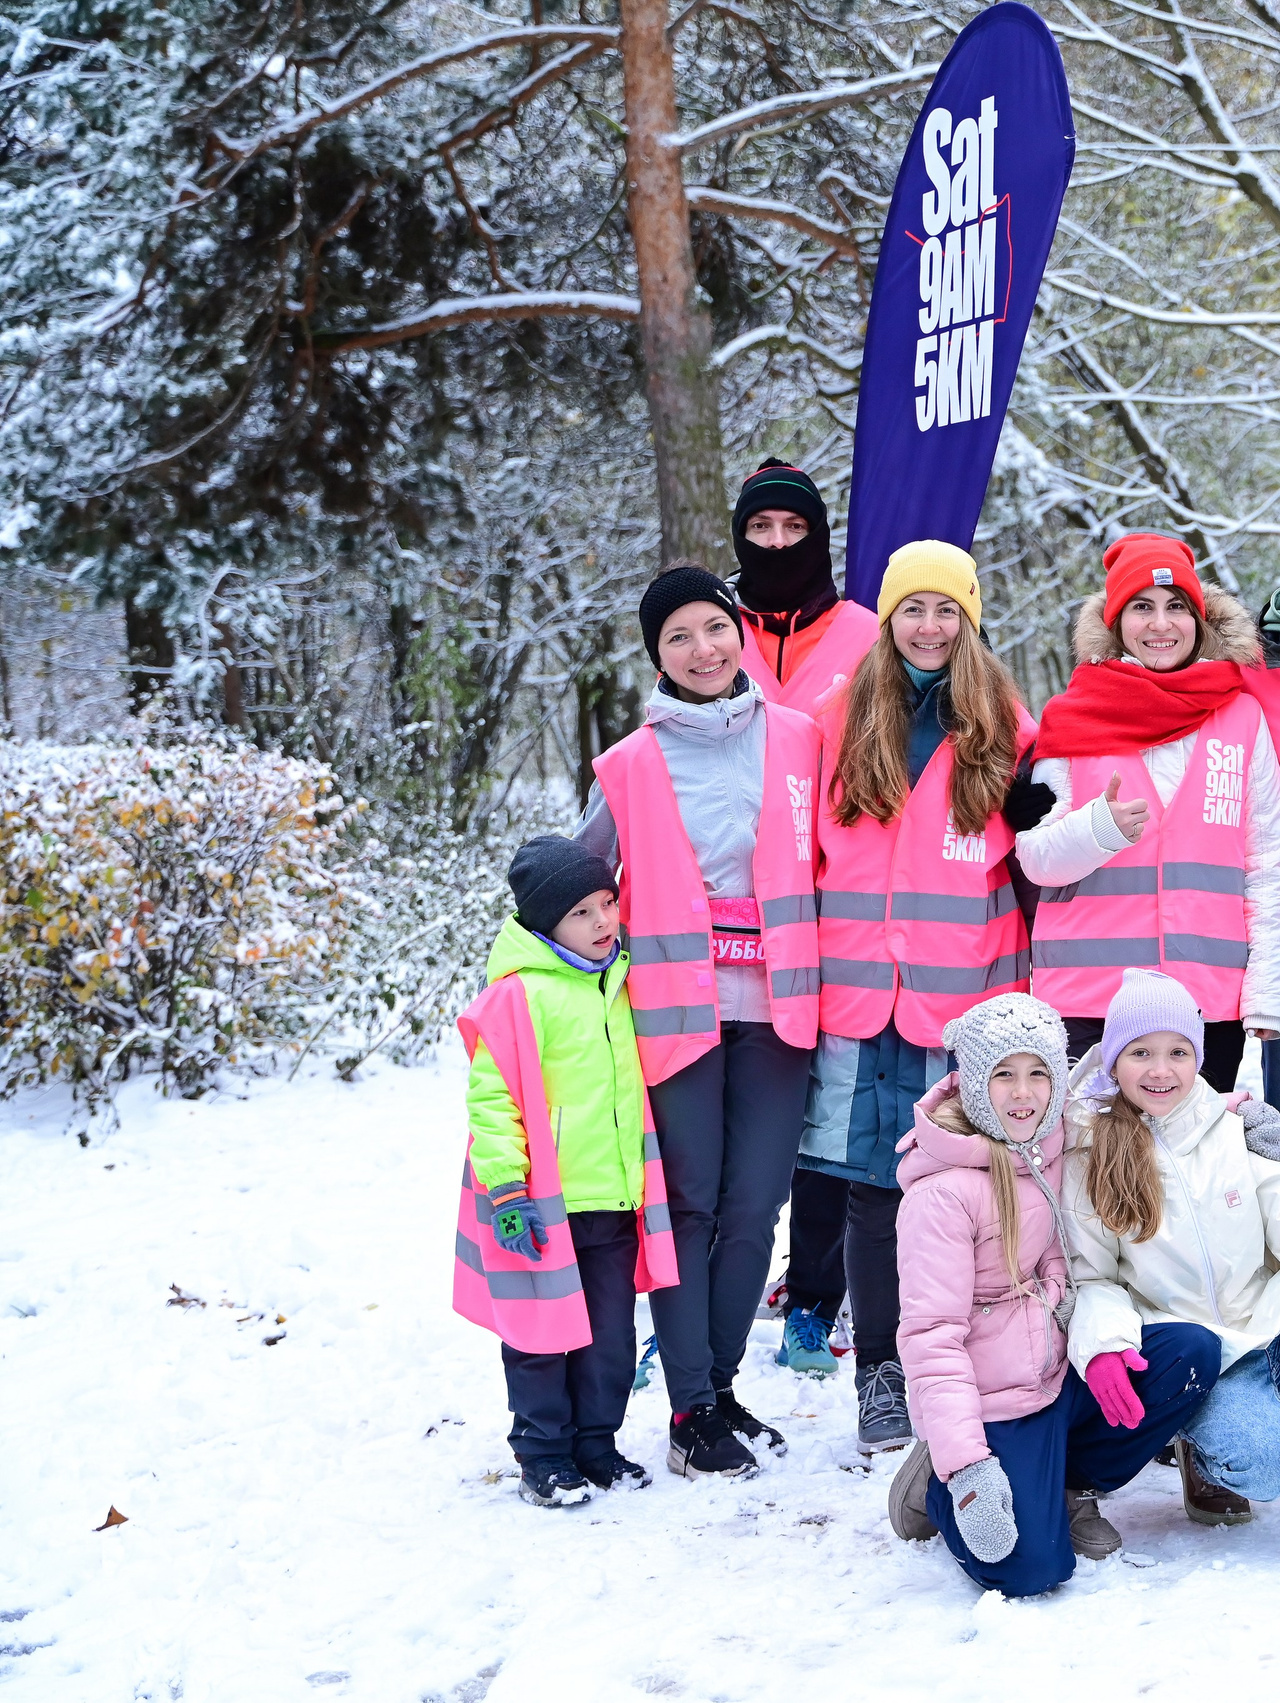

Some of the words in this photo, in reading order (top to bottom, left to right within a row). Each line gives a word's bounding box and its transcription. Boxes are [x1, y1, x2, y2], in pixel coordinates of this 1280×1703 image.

[922, 95, 998, 236] Sat
[918, 216, 997, 334] 9AM
[914, 318, 995, 432] 5KM
[1206, 738, 1245, 776] Sat
[786, 774, 812, 809] Sat
[1205, 770, 1243, 802] 9AM
[1202, 797, 1242, 828] 5KM
[795, 834, 812, 861] 5K
[942, 833, 986, 863] 5KM
